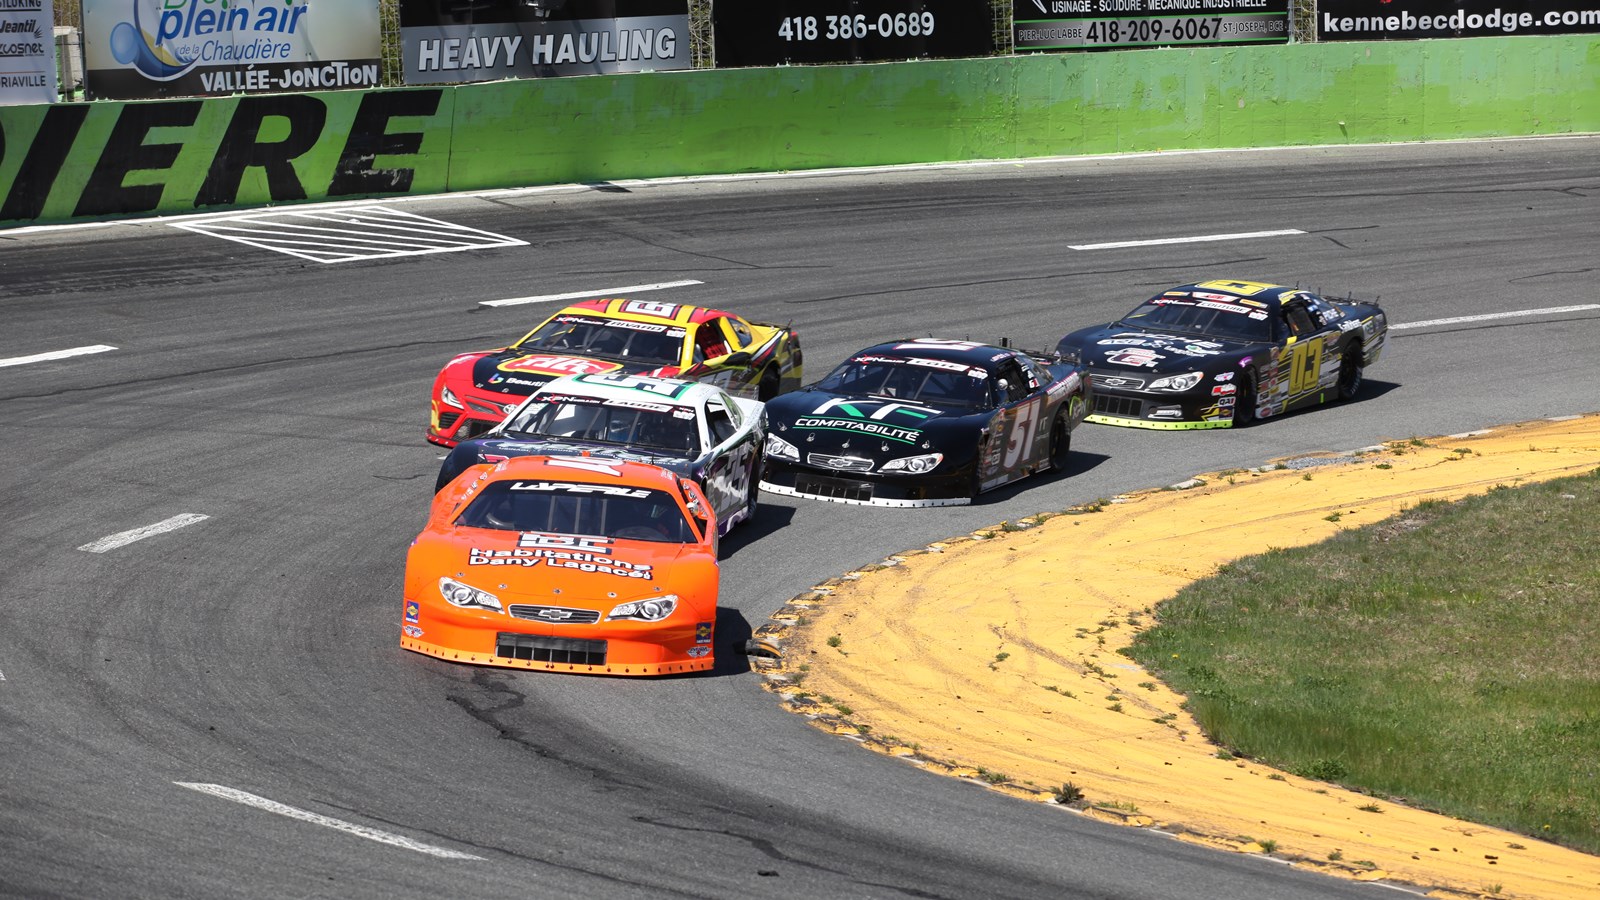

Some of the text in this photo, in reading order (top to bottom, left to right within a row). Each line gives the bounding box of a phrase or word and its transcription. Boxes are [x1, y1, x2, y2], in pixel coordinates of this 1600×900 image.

[1052, 0, 1092, 13] USINAGE
[1099, 0, 1142, 12] SOUDURE
[0, 19, 36, 33] Jeantil
[155, 0, 308, 46] plein air
[778, 11, 935, 41] 418 386-0689
[1086, 17, 1223, 43] 418-209-6067
[1324, 8, 1600, 32] kennebecdodge.com
[1018, 29, 1056, 41] PIER-LUC
[180, 38, 291, 62] de la Chaudière
[418, 26, 677, 72] HEAVY HAULING
[0, 75, 46, 88] RIAVILLE
[200, 61, 379, 92] VALLÉE-JONCTION
[0, 89, 443, 220] IERE
[1288, 337, 1324, 396] 03
[811, 397, 945, 420] KF
[795, 418, 920, 442] COMPTABILITÉ
[1002, 397, 1042, 469] 51
[468, 555, 542, 567] Dany
[469, 547, 653, 572] Habitations
